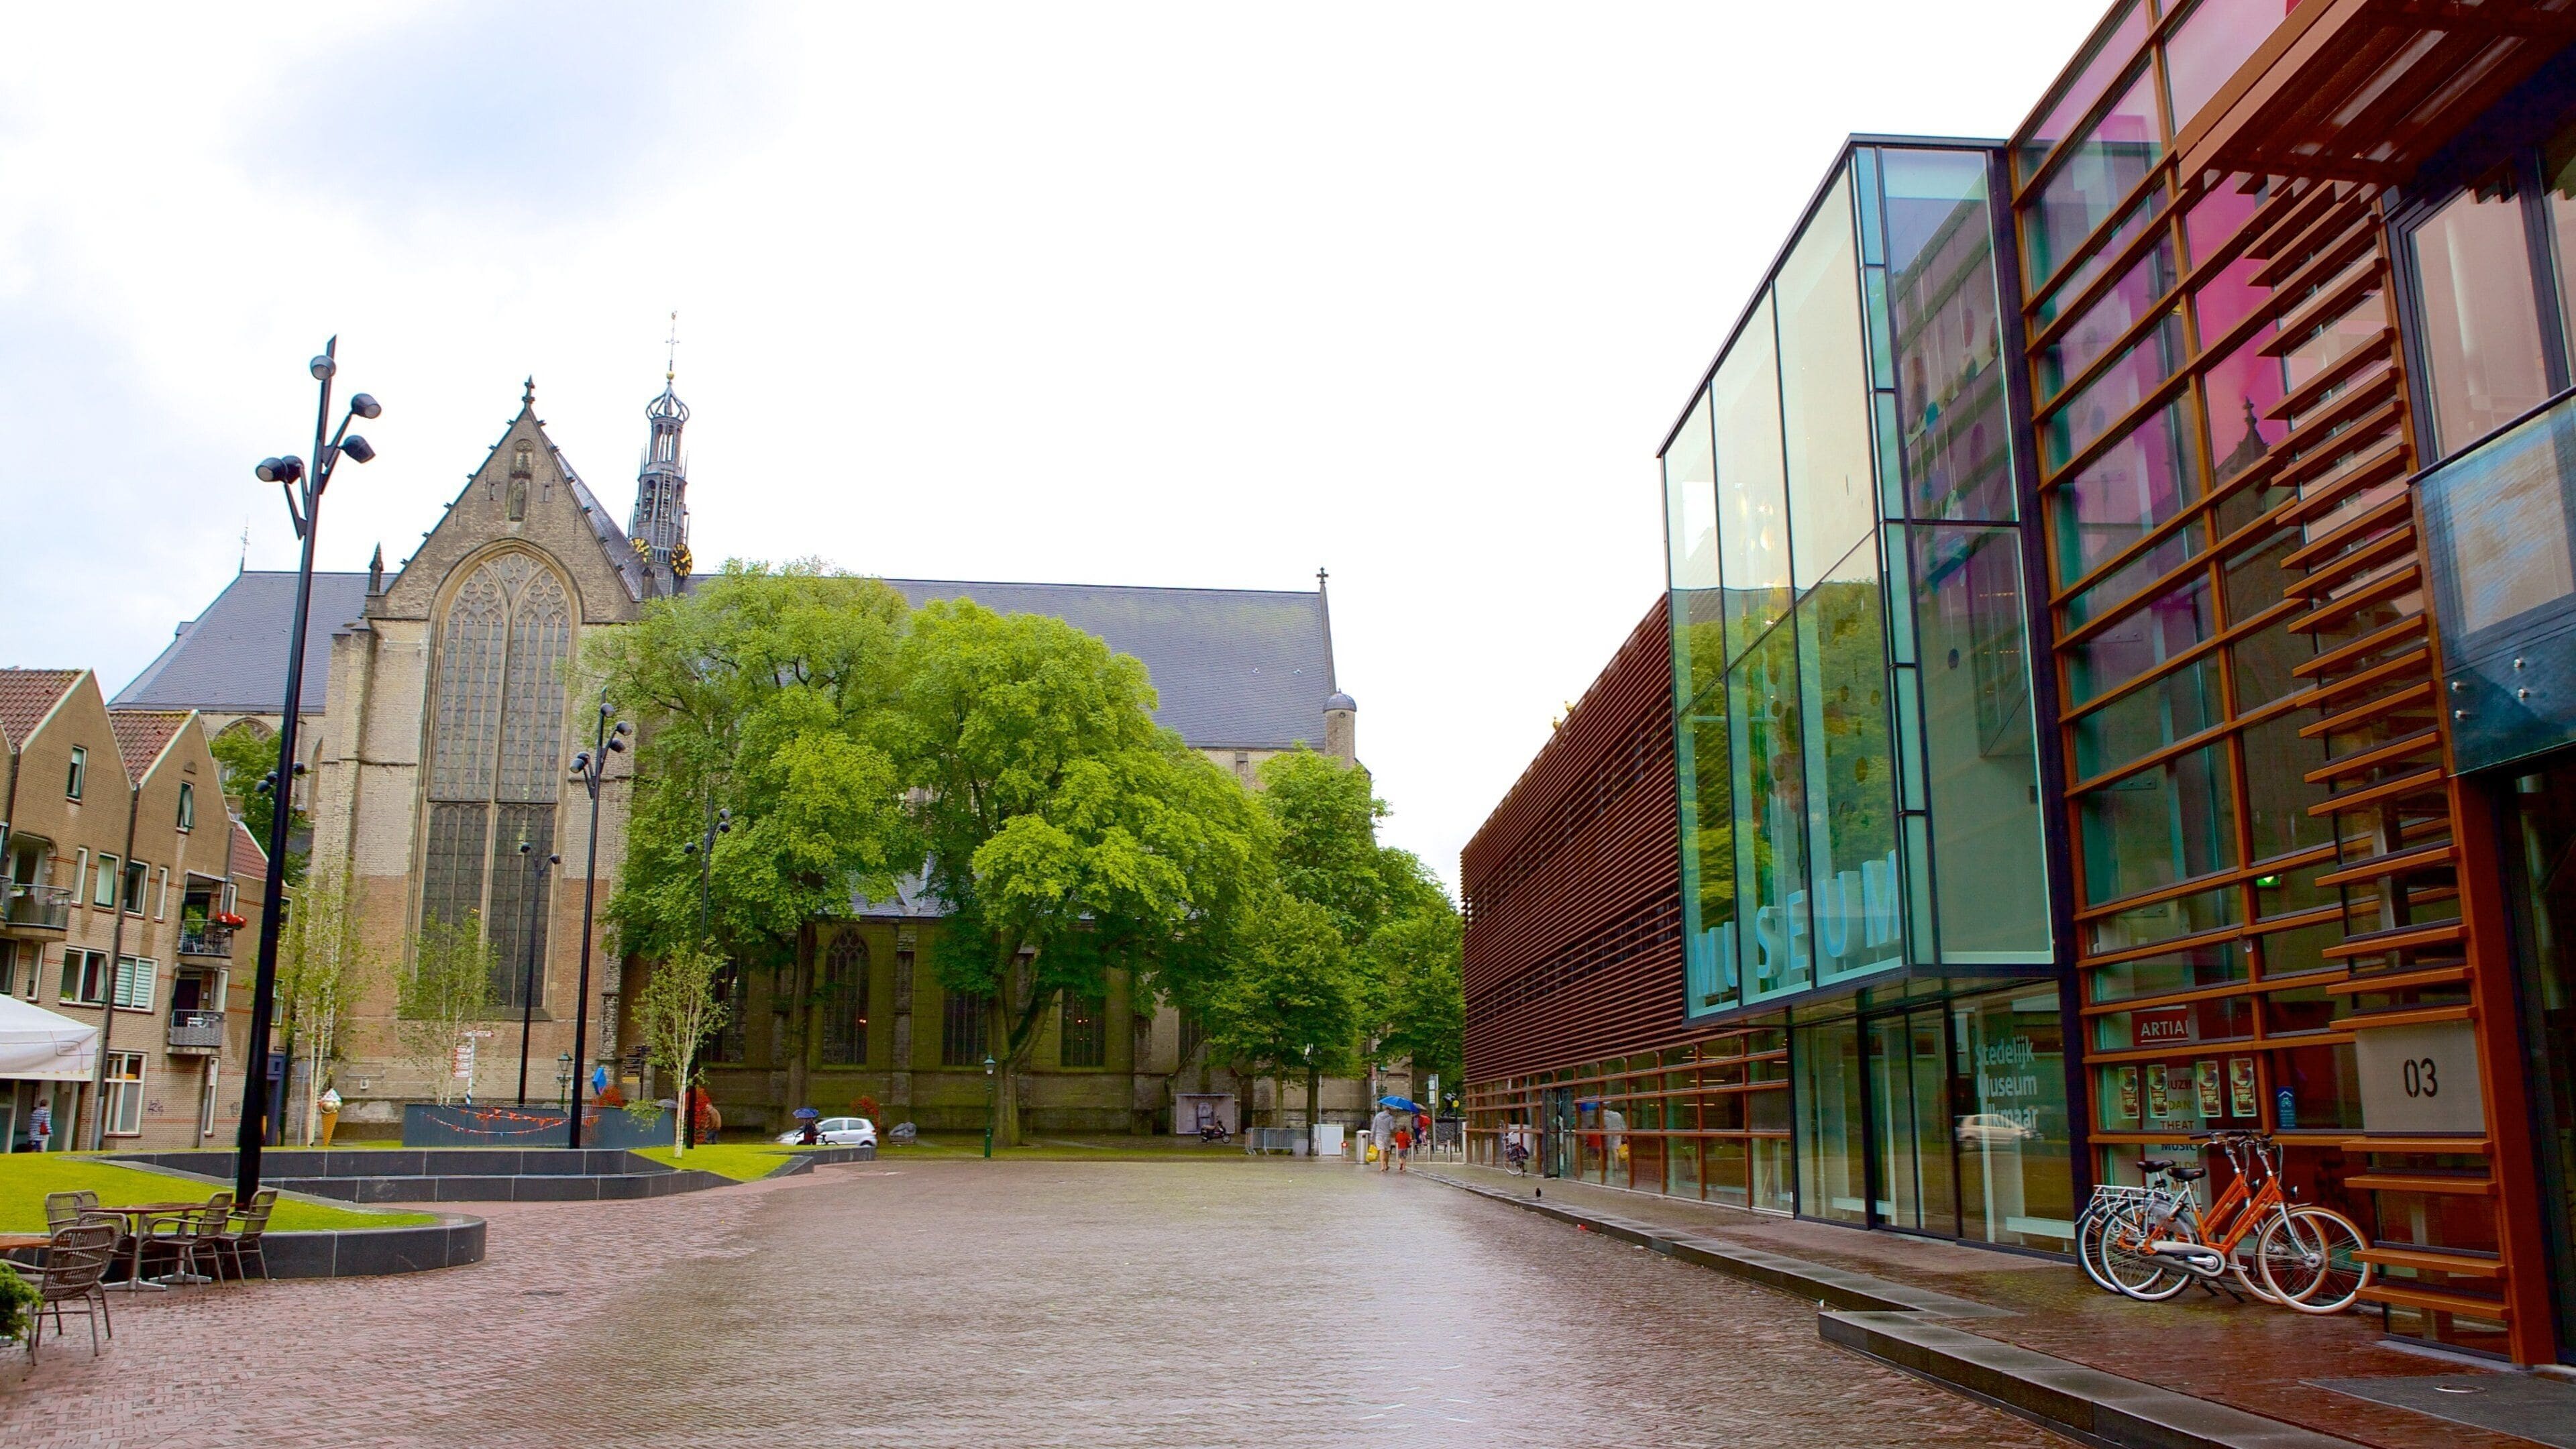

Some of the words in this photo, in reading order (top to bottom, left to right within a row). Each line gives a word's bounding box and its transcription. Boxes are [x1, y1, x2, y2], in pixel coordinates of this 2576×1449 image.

[1975, 1034, 2035, 1069] Stedelijk
[2404, 1058, 2438, 1097] 03
[1982, 1103, 2039, 1130] lkmaar
